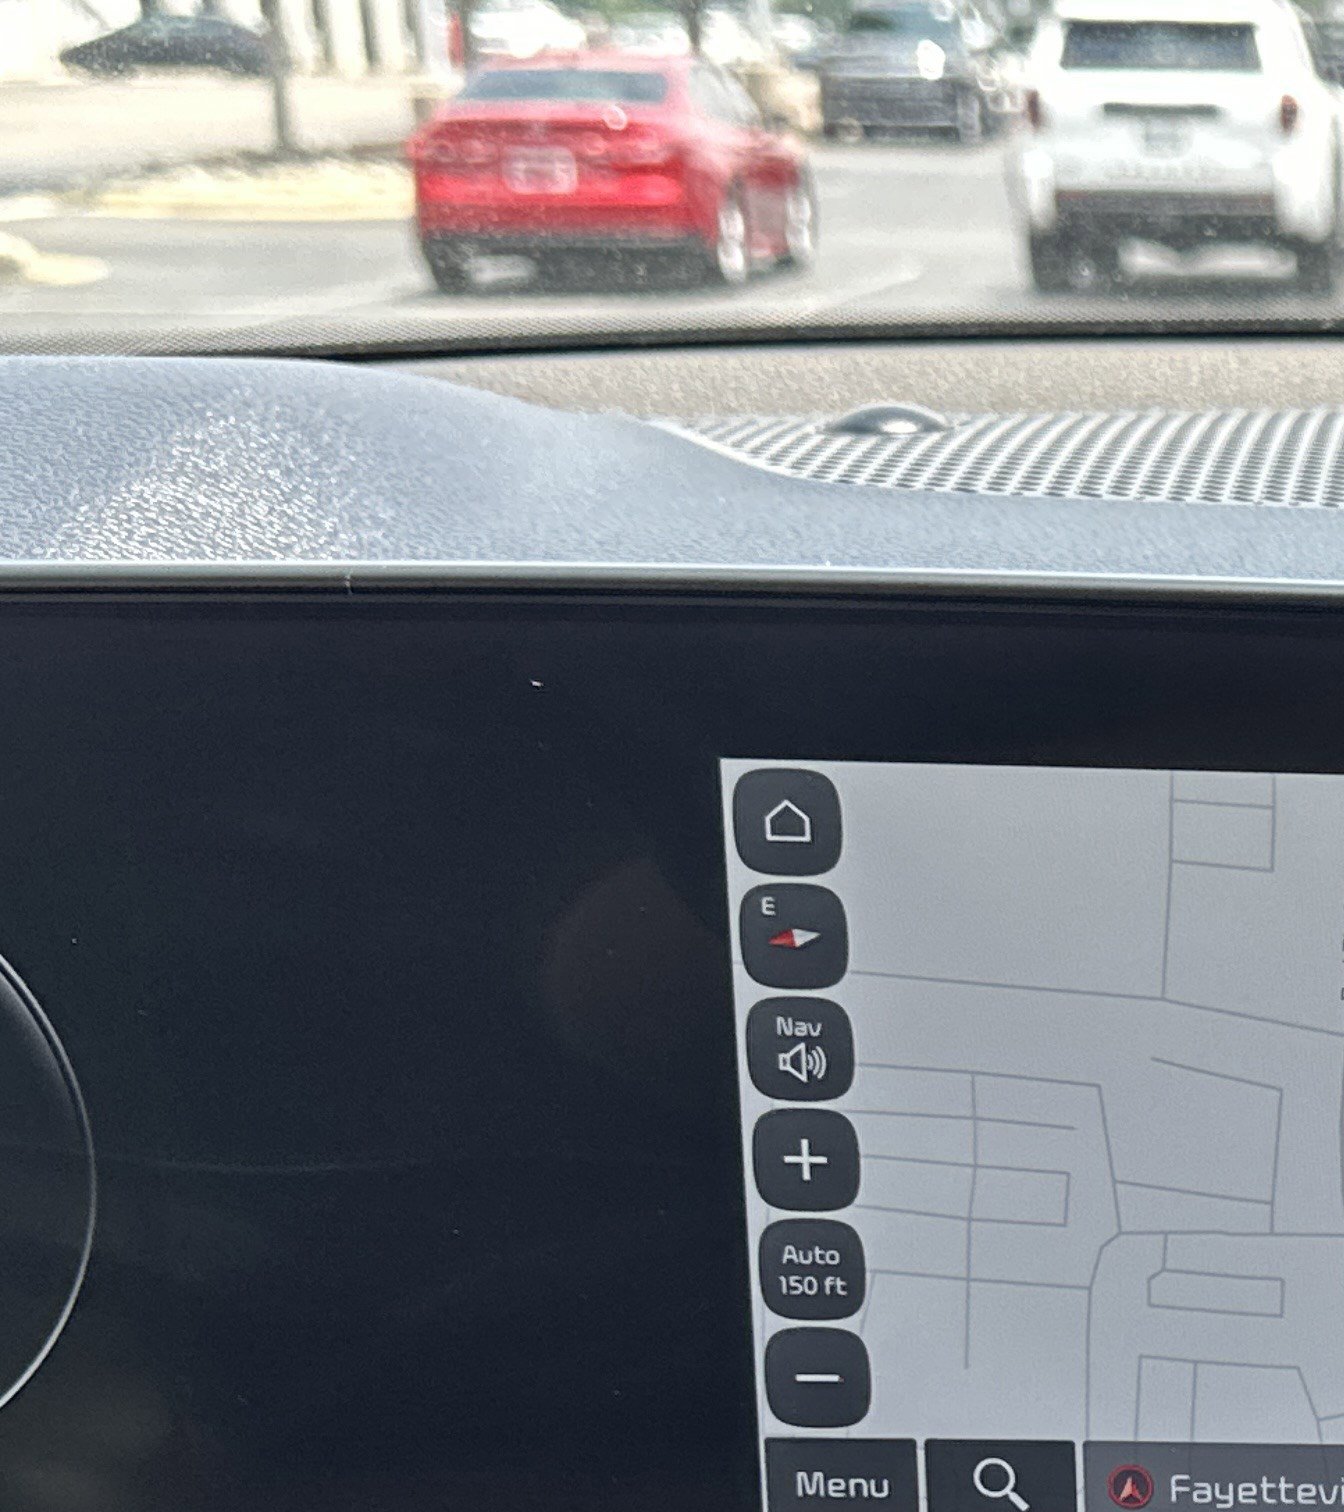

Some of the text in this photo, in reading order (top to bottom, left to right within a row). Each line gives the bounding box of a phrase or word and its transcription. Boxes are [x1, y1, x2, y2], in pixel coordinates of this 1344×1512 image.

[761, 898, 775, 915] E
[776, 1017, 821, 1038] Nav
[783, 1245, 840, 1267] Auto
[779, 1274, 847, 1296] 150 ft
[796, 1472, 890, 1499] Menu
